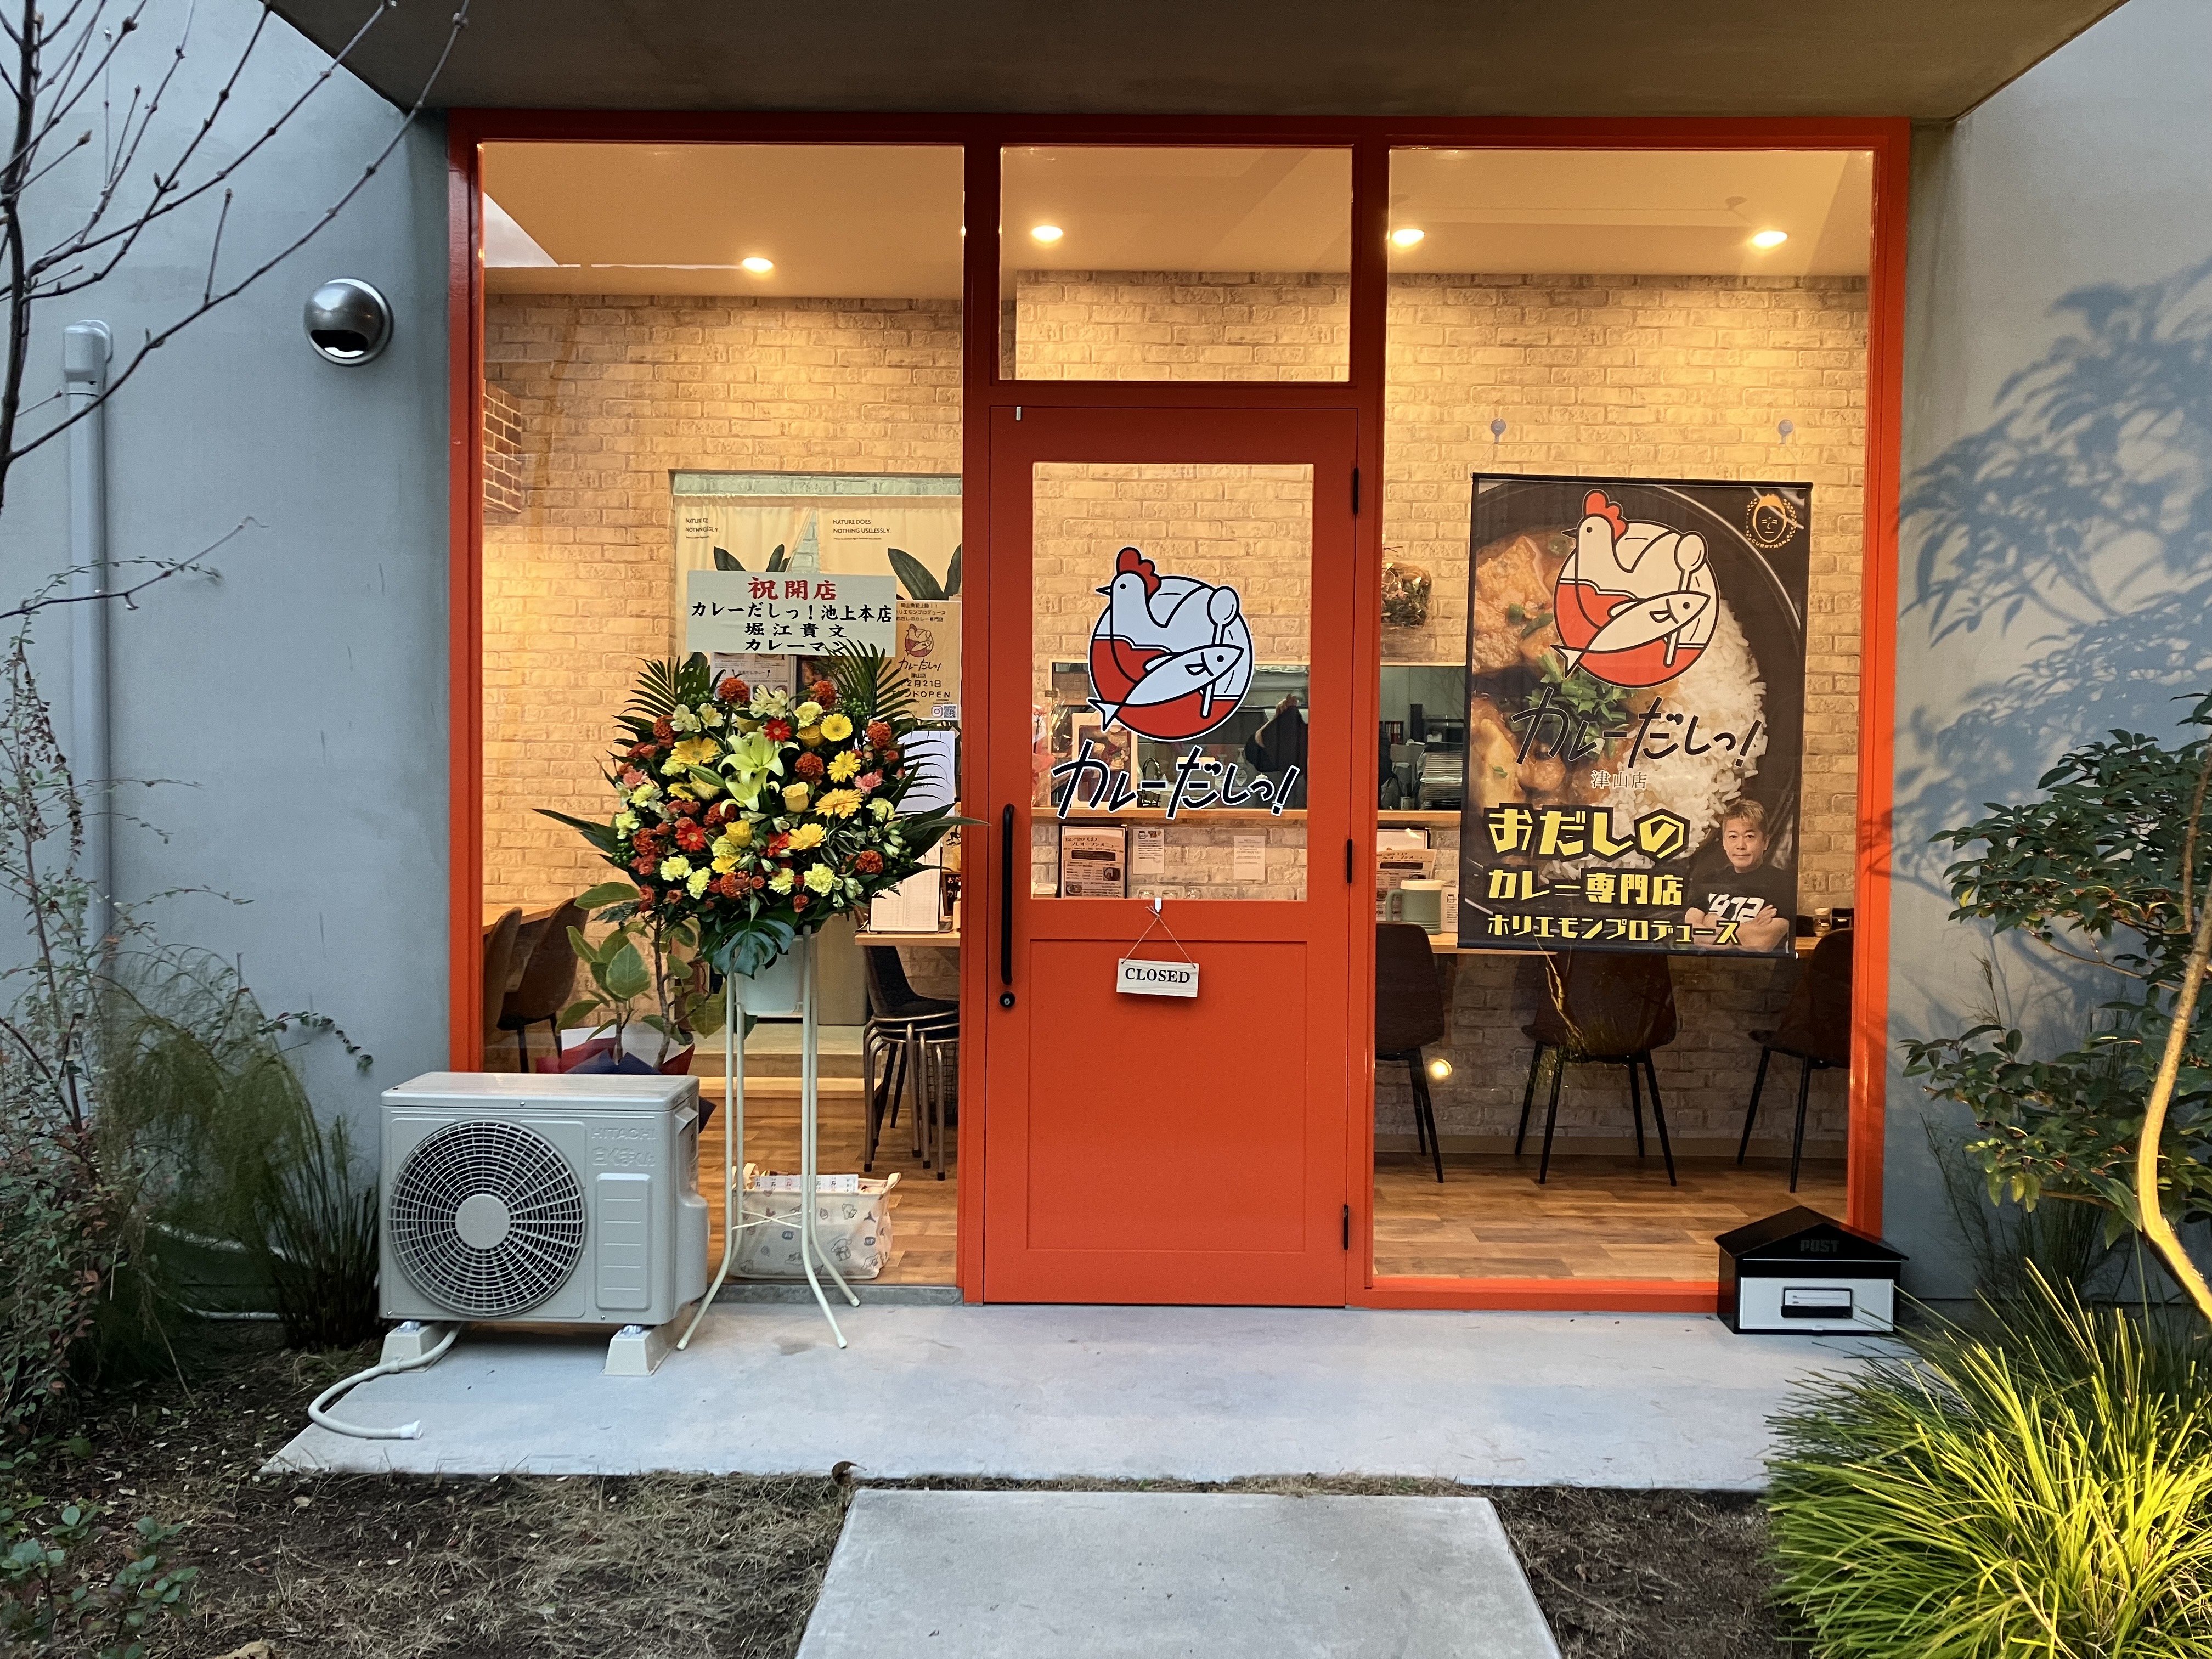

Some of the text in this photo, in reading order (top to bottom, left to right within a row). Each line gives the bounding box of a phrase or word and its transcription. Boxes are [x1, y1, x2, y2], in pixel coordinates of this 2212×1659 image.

[1752, 539, 1787, 549] CURRYMAN
[747, 577, 837, 600] 祝開店
[744, 622, 847, 638] 堀江貴文
[901, 680, 941, 688] 2月21日
[1590, 770, 1647, 789] 津山店
[1488, 808, 1685, 859] おだしの
[1488, 869, 1684, 906] カレー専門店
[1487, 915, 1741, 944] ホリエモンプロデュース
[1125, 968, 1190, 983] CLOSED
[591, 1128, 656, 1140] HITACHI
[1800, 1239, 1839, 1252] POST
